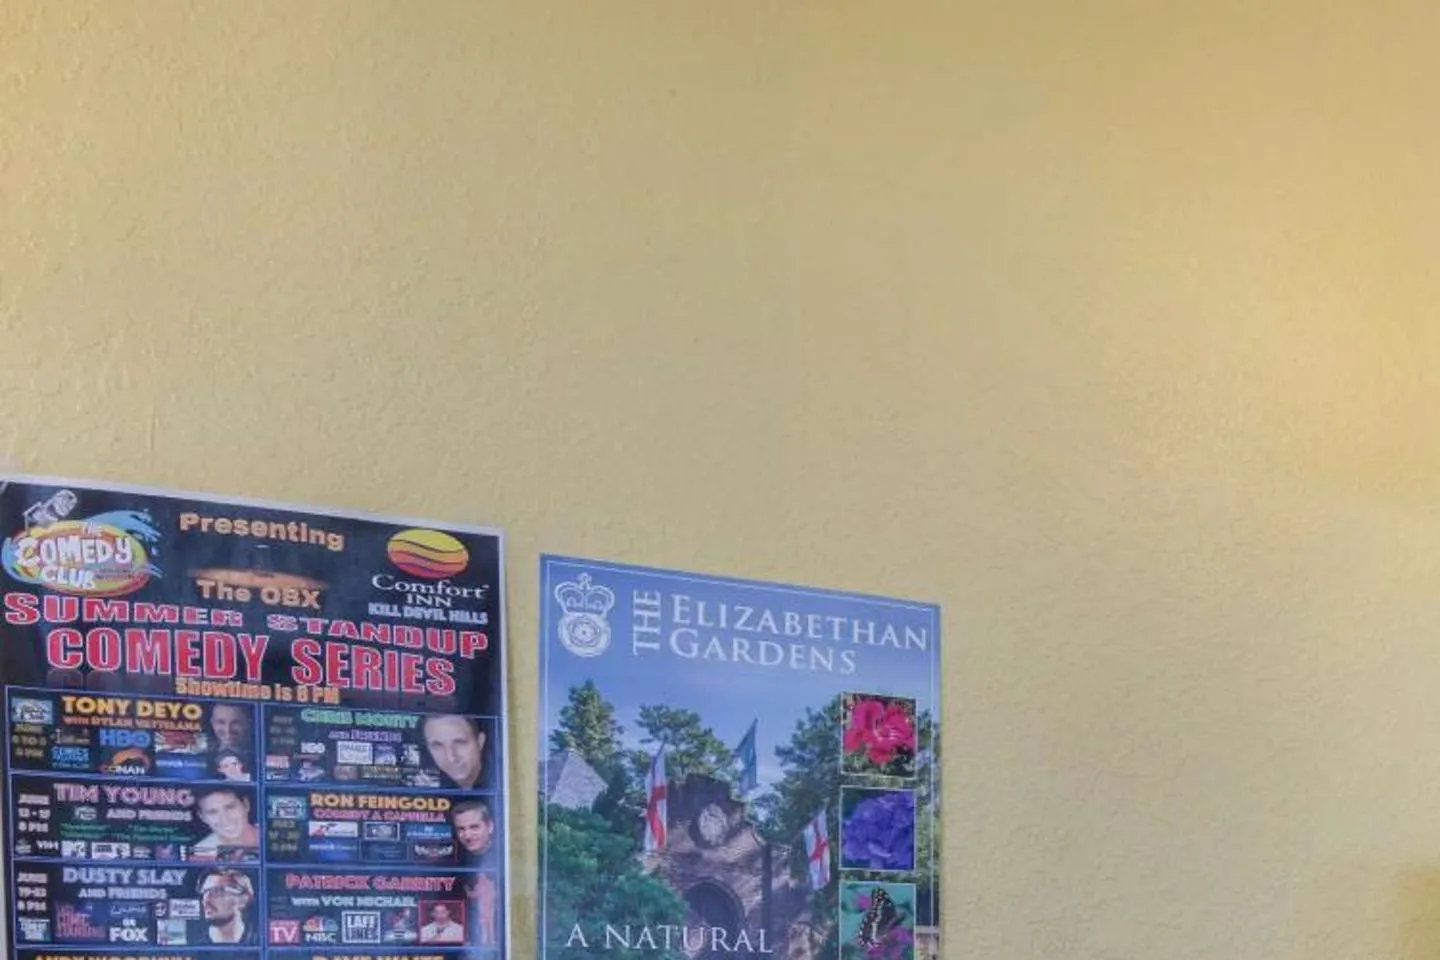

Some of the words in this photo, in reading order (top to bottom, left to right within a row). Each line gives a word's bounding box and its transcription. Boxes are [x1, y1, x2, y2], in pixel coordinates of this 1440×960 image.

[179, 512, 345, 551] Presenting
[16, 535, 133, 568] COMEDY
[40, 564, 96, 589] CLUB
[371, 573, 486, 599] Comfort
[196, 579, 251, 602] The
[260, 585, 320, 610] OBX
[406, 593, 452, 608] INN
[368, 602, 402, 617] KILL
[403, 605, 447, 621] DEVIL
[448, 609, 489, 624] HILLS
[632, 589, 662, 655] THE
[671, 594, 928, 652] ELIZABETHAN
[5, 592, 243, 627] SUMMER
[266, 613, 489, 660] STANDUP
[47, 627, 270, 681] COMEDY
[291, 638, 457, 696] SERIES
[669, 627, 858, 675] GARDENS
[175, 676, 272, 700] Showtime
[275, 682, 293, 701] is
[312, 685, 340, 705] PM
[62, 695, 131, 716] TONY
[136, 699, 203, 720] DEYO
[100, 729, 151, 748] HBO
[53, 783, 99, 804] TIM
[103, 785, 195, 807] YOUNG
[309, 792, 355, 808] RON
[358, 795, 451, 812] FEINGOLD
[63, 867, 133, 885] DUSTY
[136, 869, 188, 886] SLAY
[78, 888, 106, 898] AND
[109, 926, 149, 942] FOX
[271, 926, 298, 943] TV
[565, 923, 590, 948] A
[604, 923, 773, 954] NATURAL
